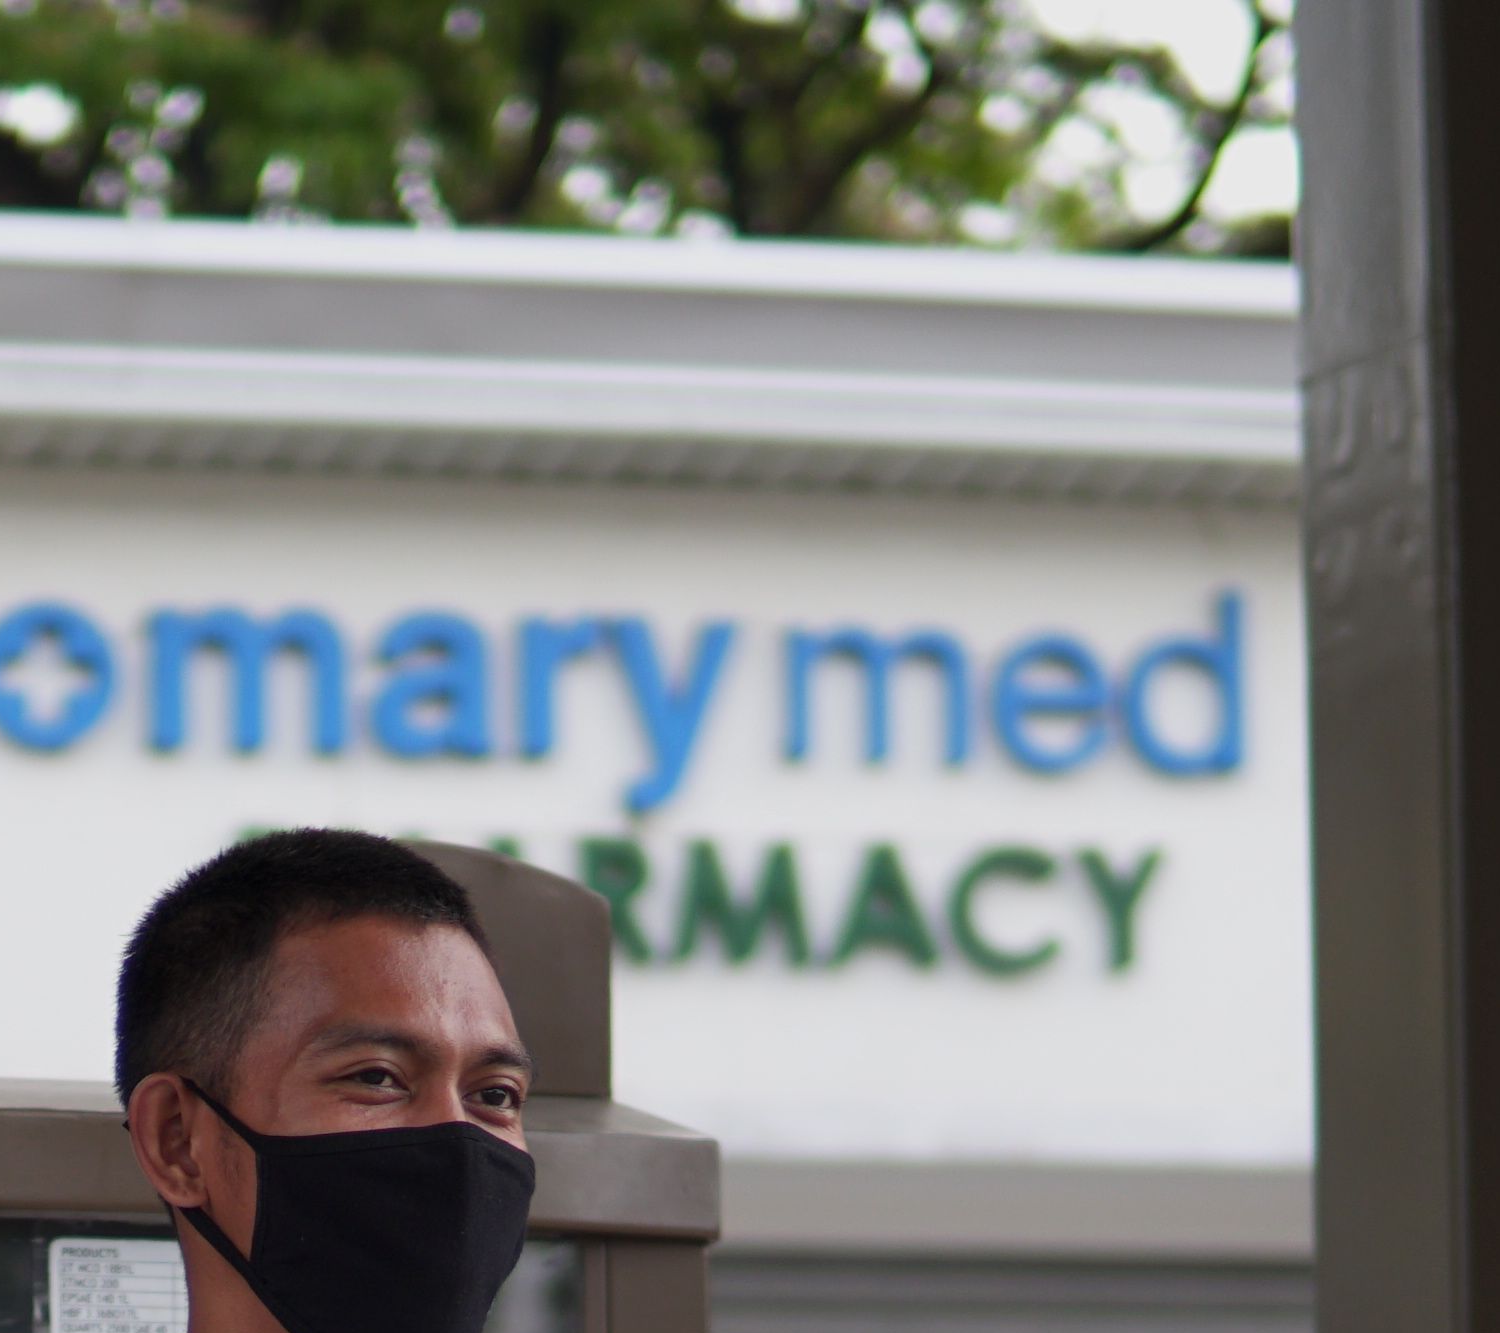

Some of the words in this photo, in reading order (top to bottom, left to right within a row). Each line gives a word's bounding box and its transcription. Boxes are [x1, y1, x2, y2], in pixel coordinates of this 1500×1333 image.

[143, 602, 735, 813] mary
[784, 592, 1247, 776] med
[237, 828, 1163, 976] RMACY
[61, 1247, 120, 1257] PRODUCTS
